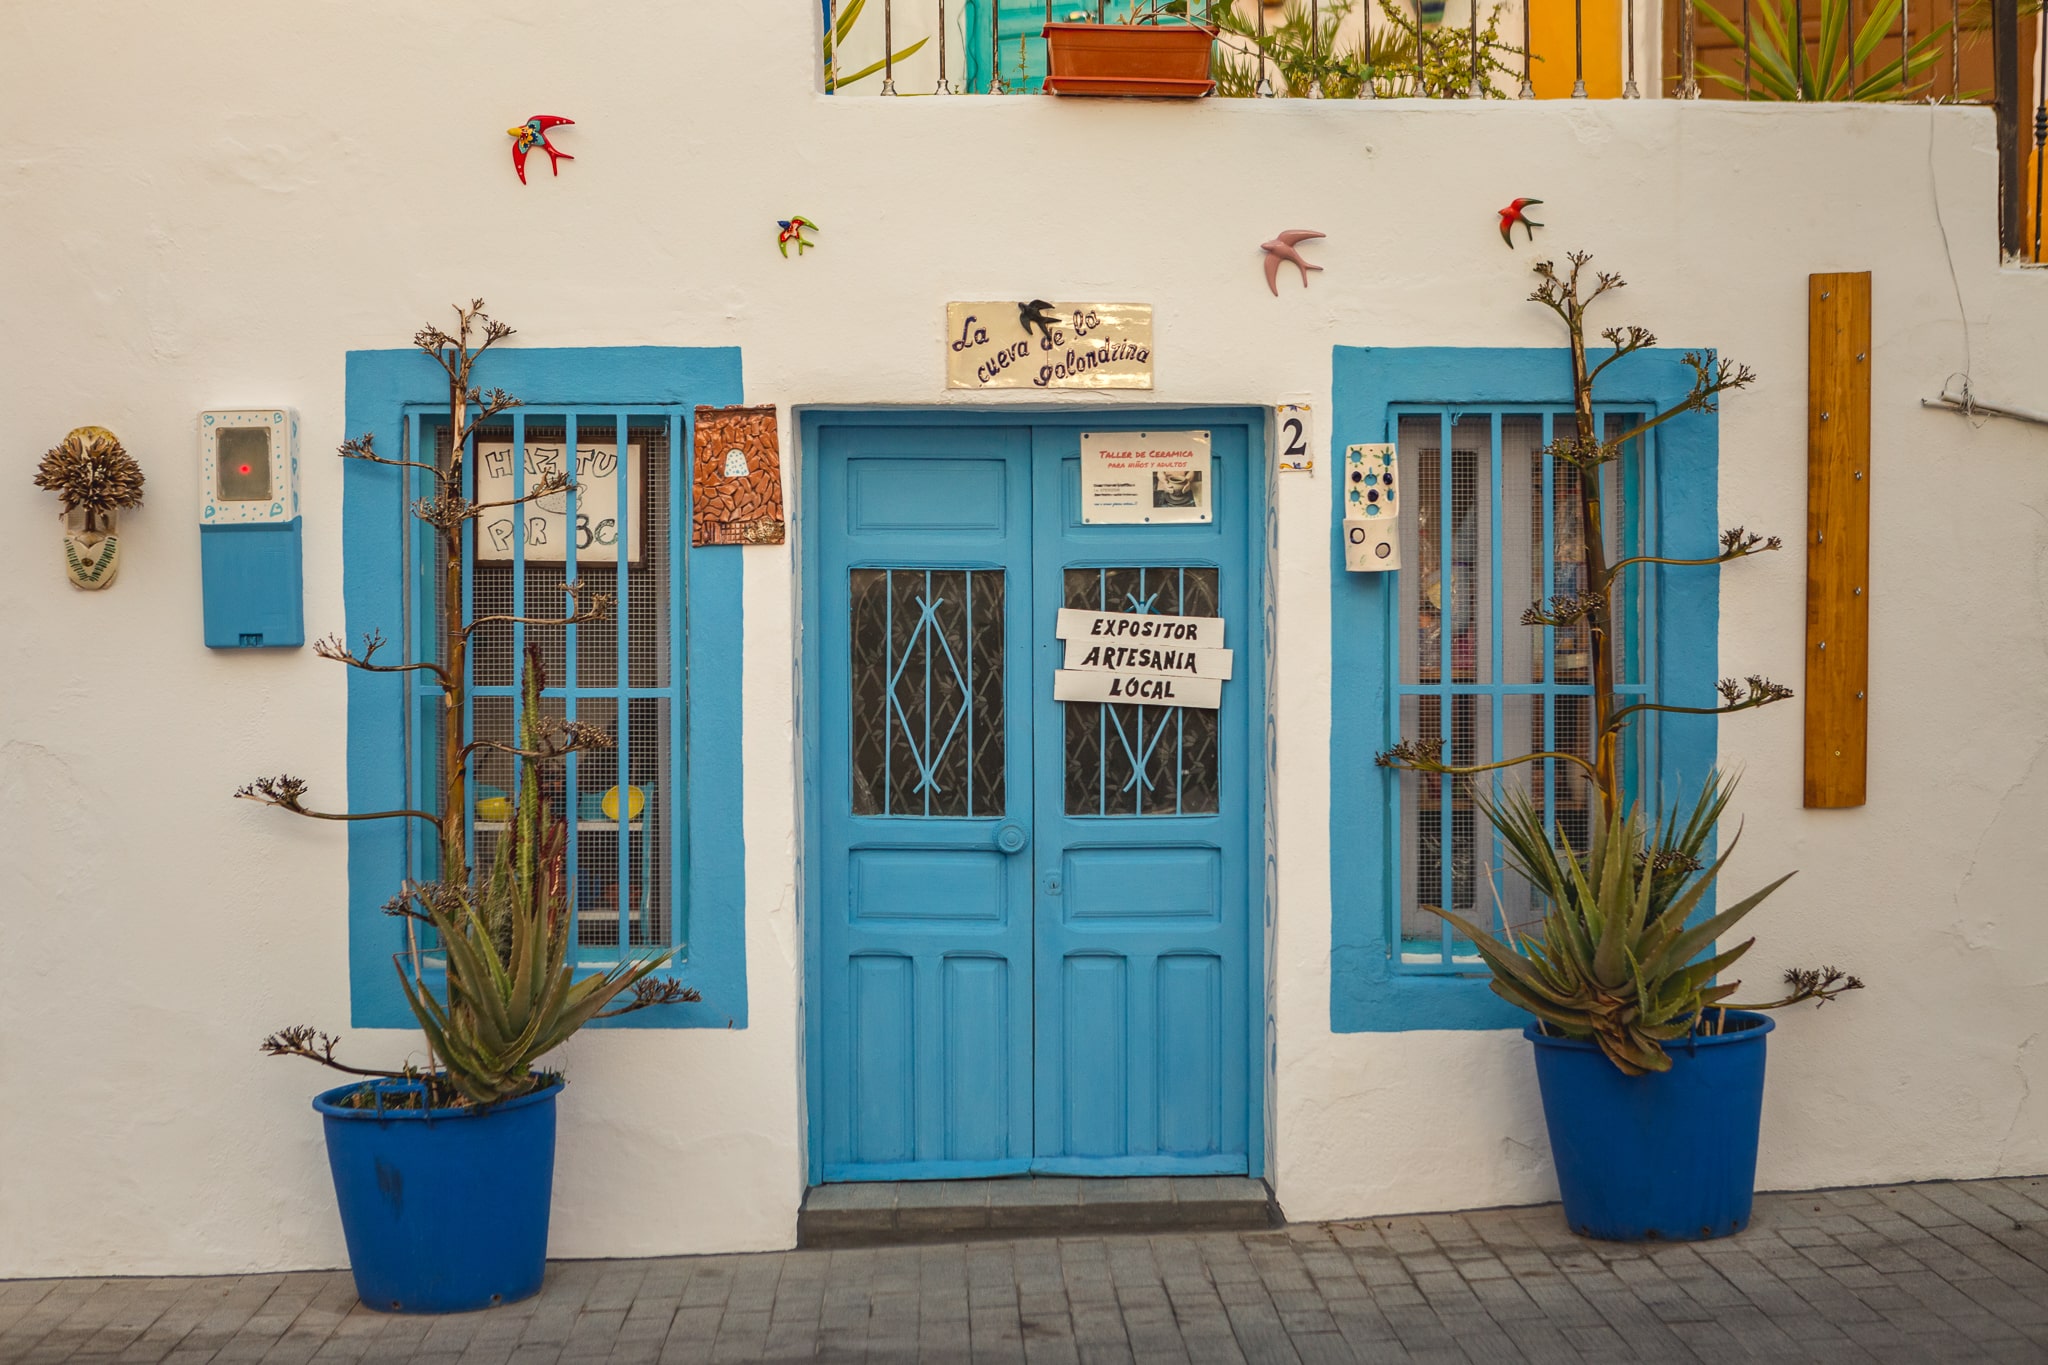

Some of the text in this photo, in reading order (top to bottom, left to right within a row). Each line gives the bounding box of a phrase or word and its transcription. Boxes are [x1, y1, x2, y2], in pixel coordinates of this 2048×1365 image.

[952, 315, 989, 352] La
[977, 310, 1101, 384] cueva de la
[1033, 336, 1150, 386] golondrina
[1282, 418, 1307, 456] 2
[572, 448, 618, 478] TU
[1127, 460, 1149, 469] NIÑOS
[1156, 461, 1188, 469] ADULTOS
[1090, 618, 1198, 641] EXPOSITOR
[1081, 646, 1198, 674] ARTESANIA
[1109, 676, 1176, 700] LOCAL
